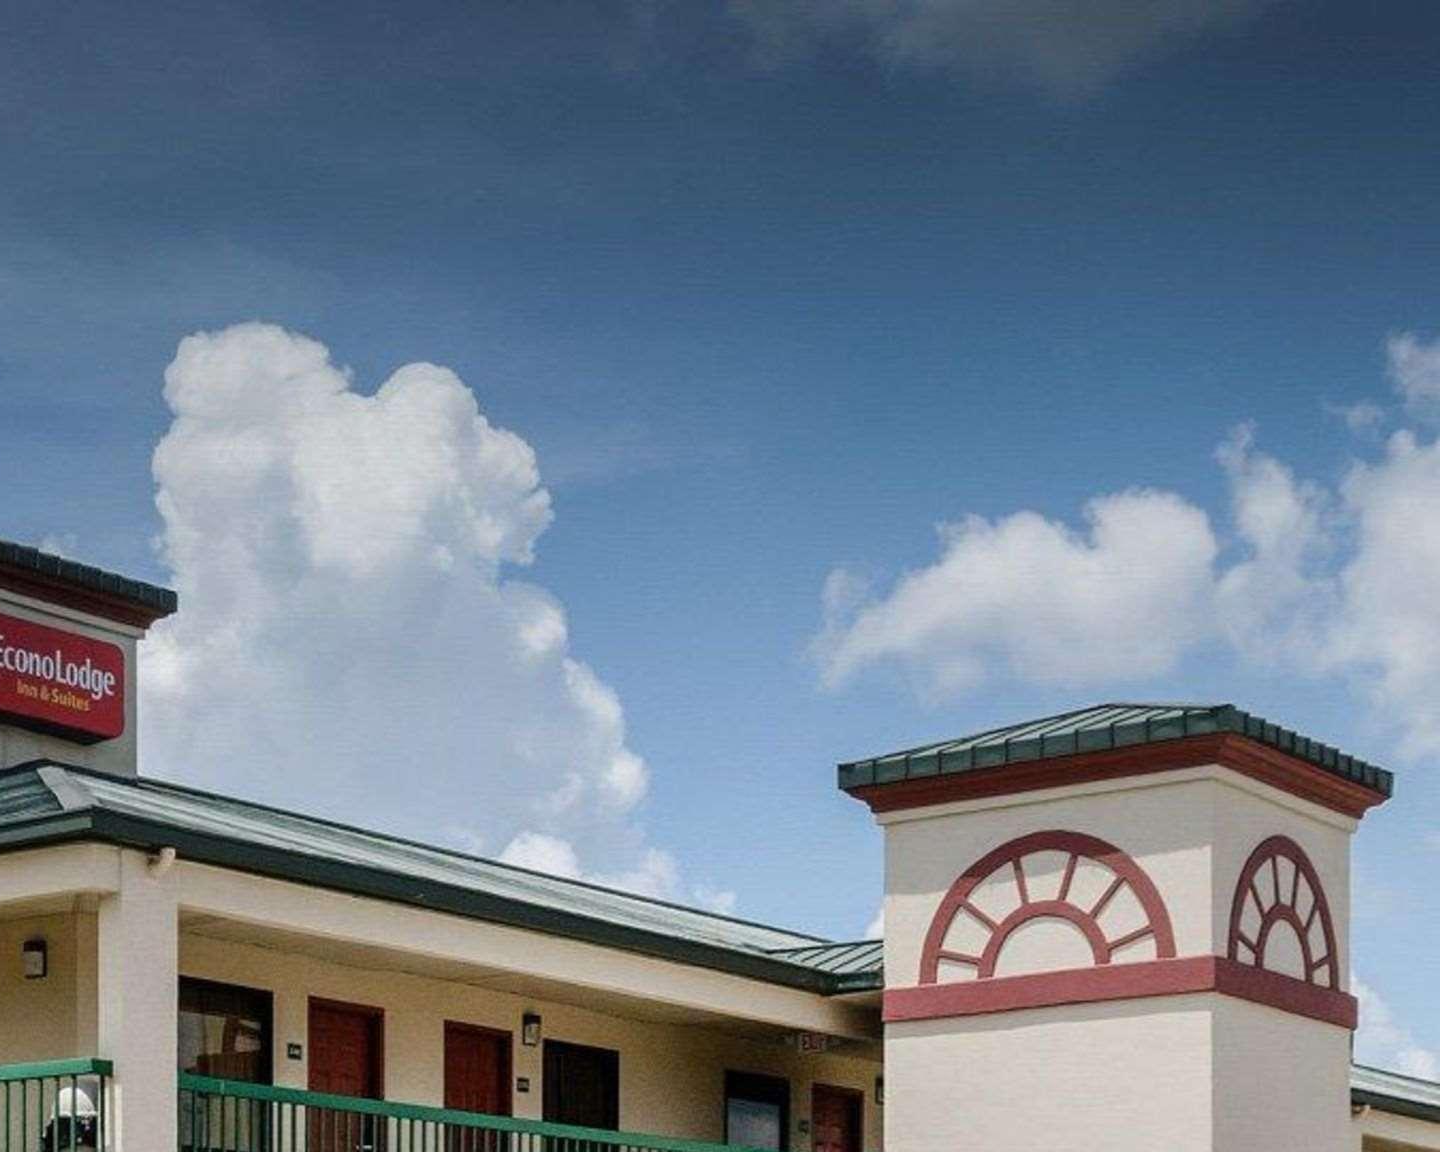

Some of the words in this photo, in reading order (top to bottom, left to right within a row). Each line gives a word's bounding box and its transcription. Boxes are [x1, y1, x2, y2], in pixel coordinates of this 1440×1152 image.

[16, 679, 38, 699] Inn
[40, 685, 50, 701] &
[51, 688, 91, 711] Suites
